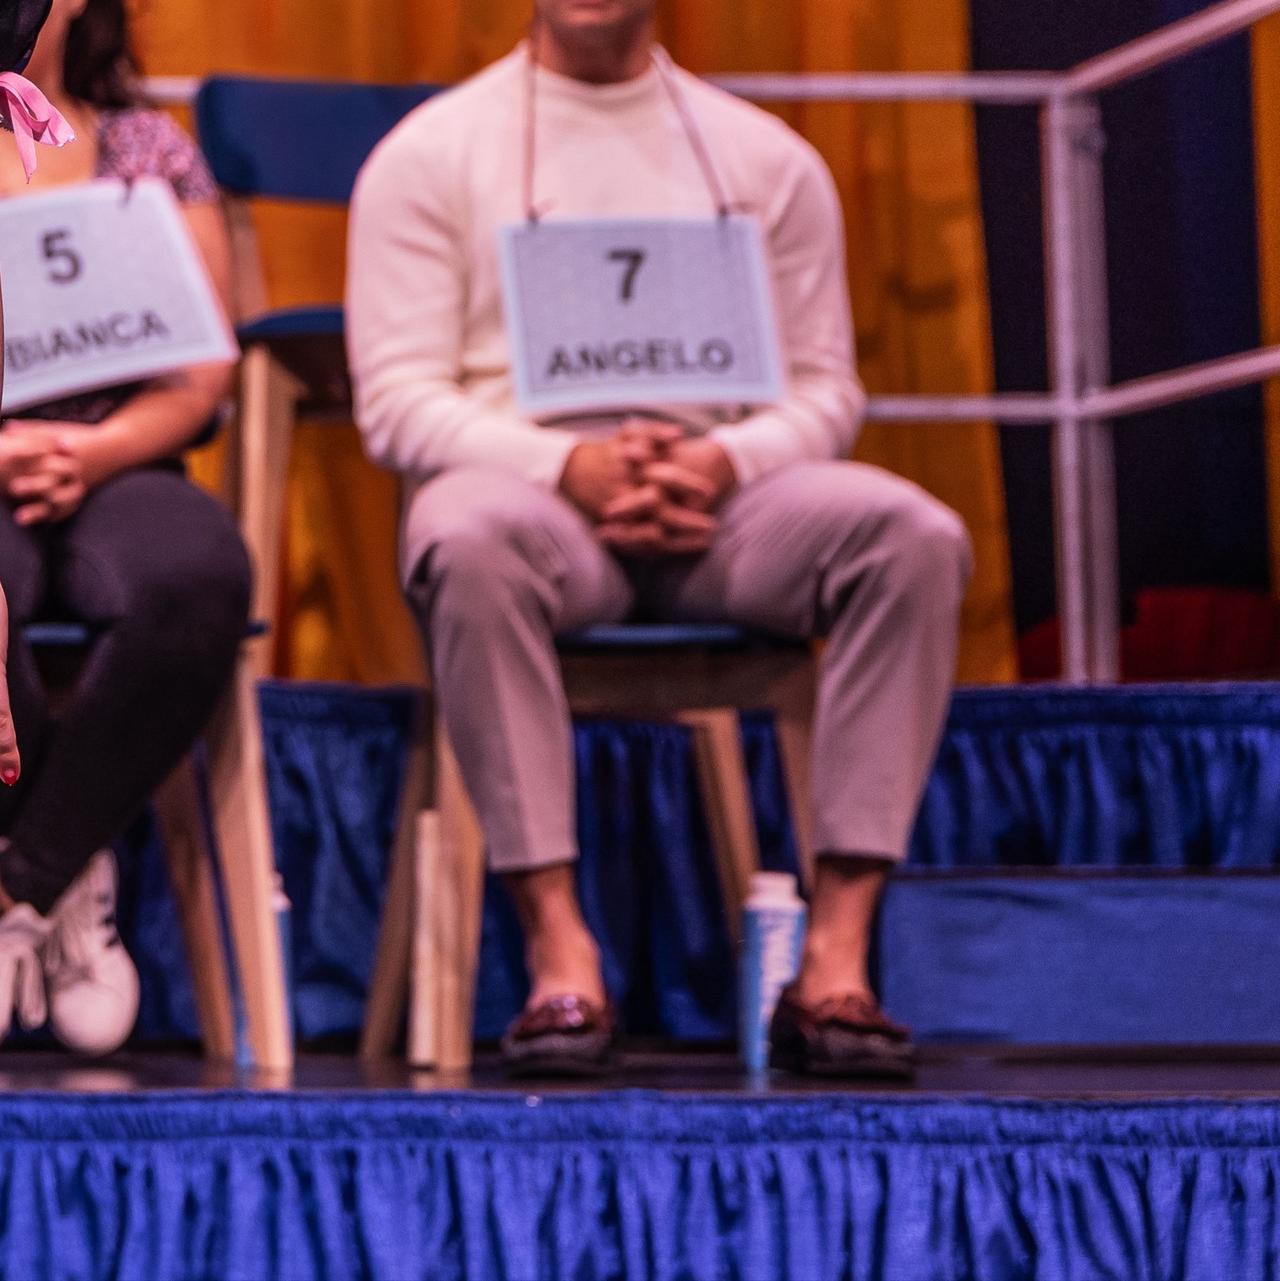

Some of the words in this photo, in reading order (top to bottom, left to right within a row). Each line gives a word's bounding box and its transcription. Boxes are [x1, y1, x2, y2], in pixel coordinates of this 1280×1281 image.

[41, 229, 81, 285] 5
[605, 247, 647, 303] 7
[5, 311, 172, 374] BIANCA
[545, 337, 735, 380] ANGELO
